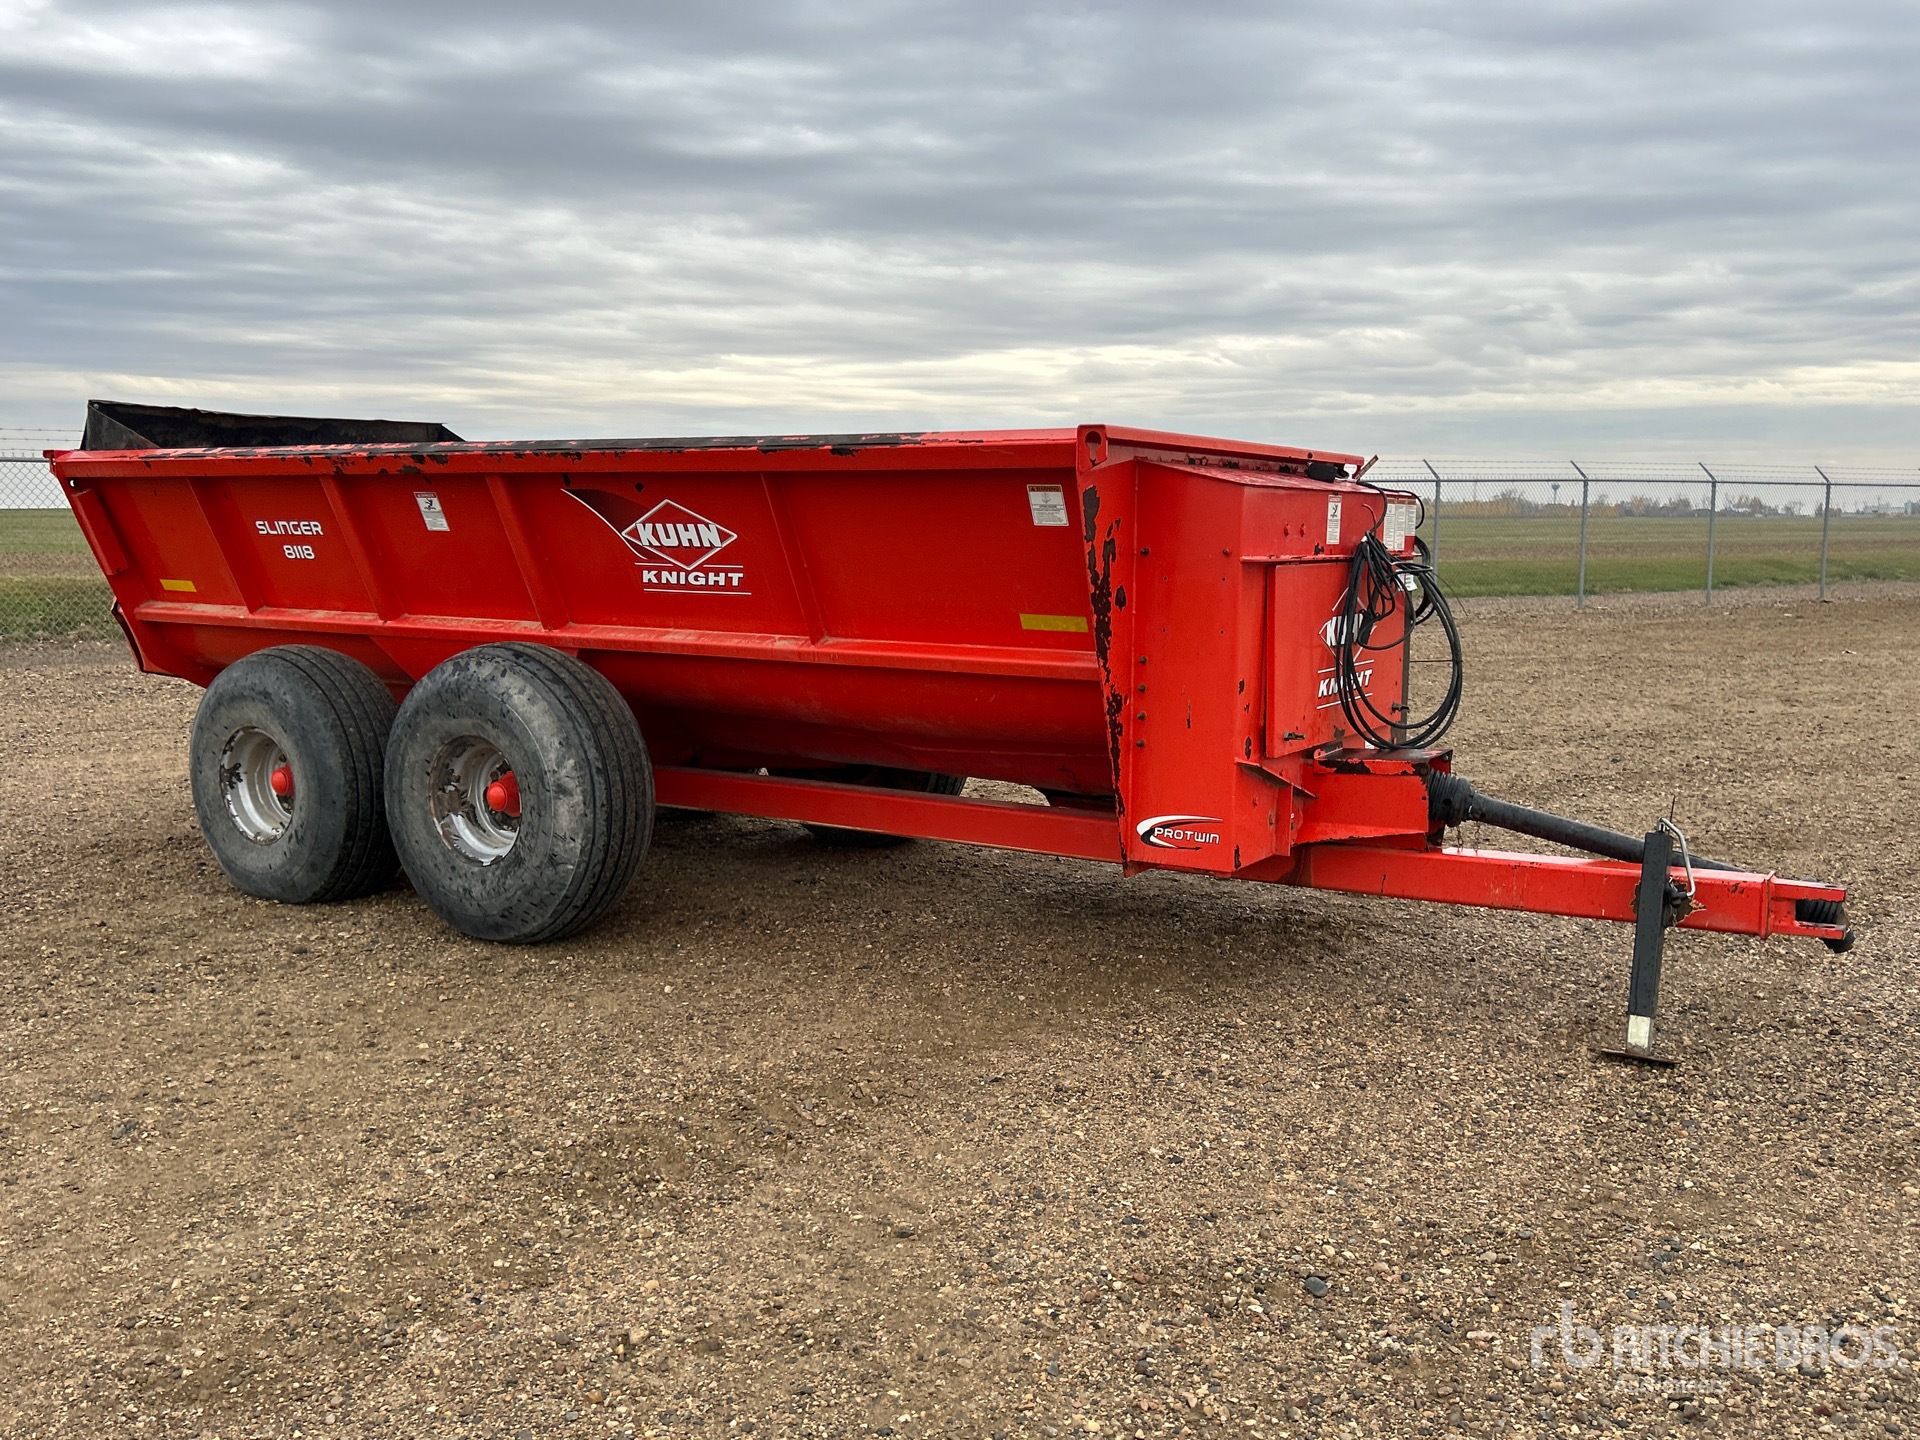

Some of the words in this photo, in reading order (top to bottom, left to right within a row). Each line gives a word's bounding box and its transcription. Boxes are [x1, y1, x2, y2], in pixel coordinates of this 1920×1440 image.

[255, 520, 324, 536] SLINGER
[635, 522, 723, 548] KUHN
[282, 545, 316, 560] 8118
[642, 570, 744, 587] KNIGHT
[1154, 827, 1220, 844] PROTWIN
